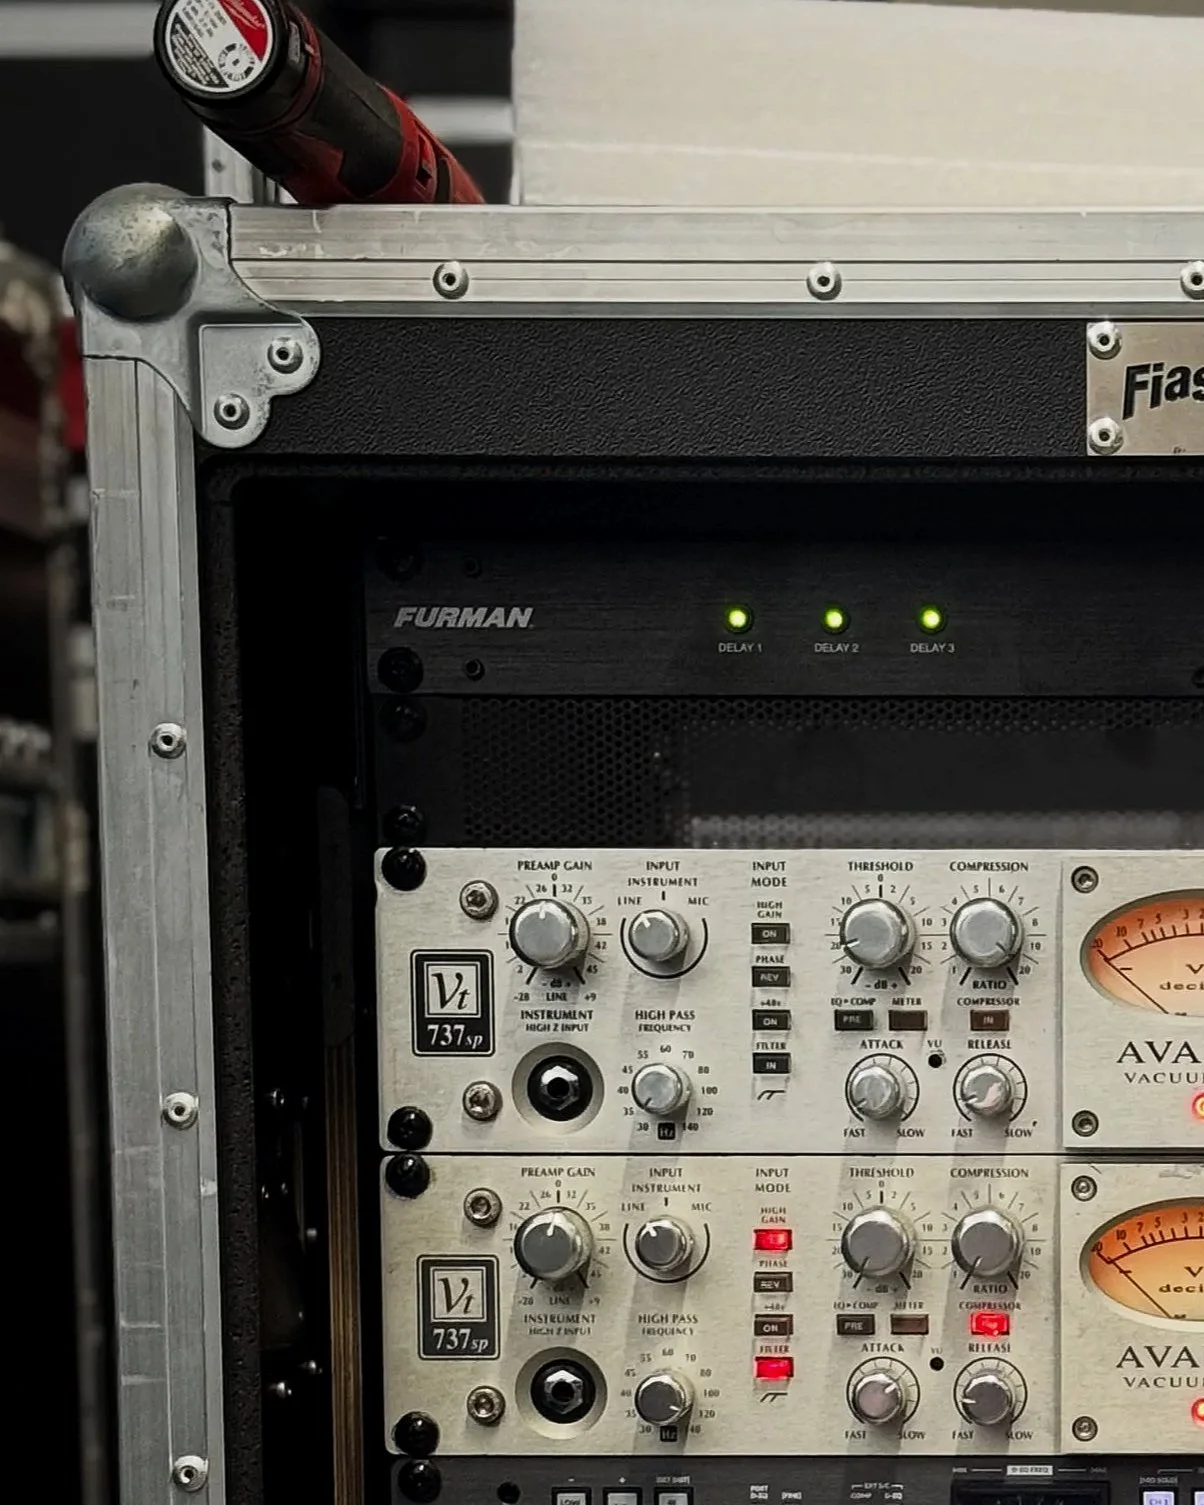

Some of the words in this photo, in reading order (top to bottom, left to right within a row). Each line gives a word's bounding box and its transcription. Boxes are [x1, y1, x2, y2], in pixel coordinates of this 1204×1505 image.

[394, 606, 532, 629] FURMAN
[718, 643, 752, 654] DELAY
[814, 643, 849, 654] DELAY
[910, 643, 945, 654] DELAY
[517, 861, 560, 871] PREAMP
[564, 861, 592, 870] GAIN
[646, 861, 680, 871] INPUT
[752, 861, 786, 871] INPUT
[848, 862, 913, 871] THRESHOLD
[950, 862, 1029, 872] COMPRESSION
[628, 877, 697, 887] INSTRUMENT
[751, 877, 787, 888] MODE
[756, 955, 784, 963] PHASE
[972, 980, 1007, 990] RATIO
[520, 1010, 593, 1020] INSTRUMENT
[635, 1011, 666, 1020] HIGH
[669, 1011, 695, 1020] PASS
[763, 1018, 778, 1027] ON
[427, 1025, 484, 1049] 737sp
[860, 1040, 903, 1049] ATTACK
[967, 1040, 1012, 1049] RELEASE
[843, 1129, 865, 1137] FAST
[897, 1129, 925, 1137] SLOW
[951, 1129, 973, 1137] FAST
[1004, 1129, 1033, 1137] SLOW
[521, 1168, 563, 1178] PREAMP
[567, 1168, 595, 1177] GAIN
[650, 1168, 682, 1178] INPUT
[755, 1168, 788, 1178] INPUT
[850, 1168, 914, 1178] THRESHOLD
[950, 1168, 1029, 1178] COMPRESSION
[755, 1183, 791, 1193] MODE
[524, 1314, 596, 1324] INSTRUMENT
[638, 1314, 669, 1323] HIGH
[673, 1314, 699, 1323] PASS
[432, 1329, 488, 1351] 737sp
